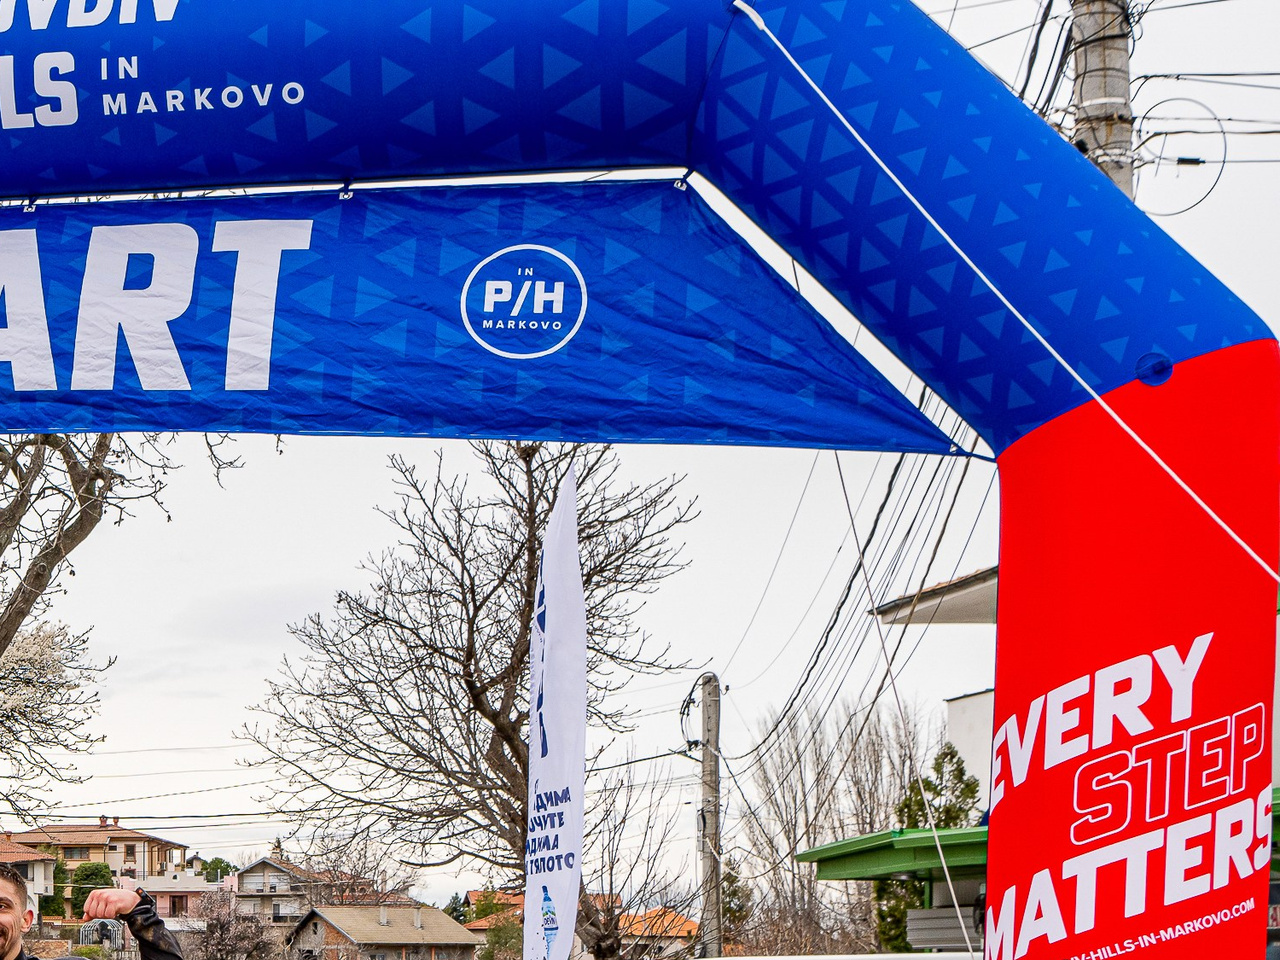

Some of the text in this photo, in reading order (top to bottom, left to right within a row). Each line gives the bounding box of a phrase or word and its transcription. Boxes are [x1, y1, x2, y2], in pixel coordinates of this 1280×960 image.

[101, 56, 138, 80] IN
[102, 81, 305, 115] MARKOVO
[517, 267, 534, 276] IN
[483, 280, 565, 317] P/H
[482, 319, 562, 330] MARKOVO
[989, 632, 1214, 816] EVERY
[1070, 702, 1266, 845] STEP
